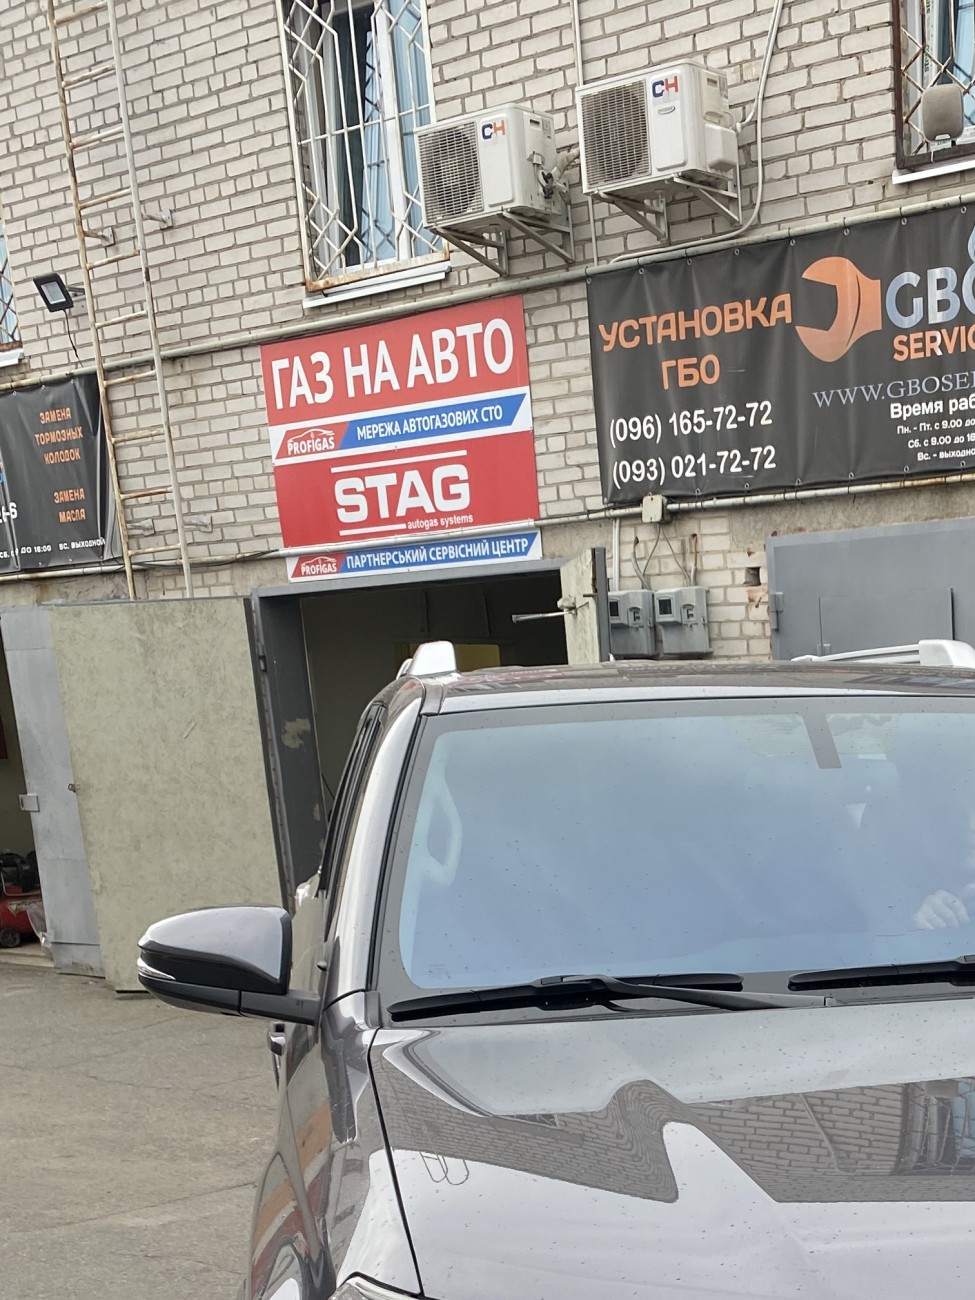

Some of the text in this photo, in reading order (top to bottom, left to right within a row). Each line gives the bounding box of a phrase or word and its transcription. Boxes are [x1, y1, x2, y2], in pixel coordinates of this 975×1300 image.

[652, 76, 678, 98] CH
[482, 120, 505, 140] CH
[599, 293, 793, 352] УСТАНОВКА
[271, 318, 514, 410] ГАЗ НА АВТО
[661, 354, 720, 390] ГБО
[39, 407, 71, 424] ЗАМЕНА
[890, 400, 943, 421] Время
[357, 405, 502, 441] МЕРЕЖА АВТОГАЗОВИХ СТО
[610, 400, 772, 448] (096) 165-72-72
[920, 422, 932, 431] Пт.
[942, 418, 962, 429] 9.00
[965, 418, 975, 427] до
[35, 427, 83, 446] ТОРМОЗНЫХ
[287, 436, 335, 455] PROFIGAS
[954, 435, 964, 444] до
[44, 448, 81, 465] КОЛОДОК
[917, 451, 931, 461] Вс.
[612, 445, 776, 490] (093) 021-72-72
[54, 488, 85, 504] ЗАМЕНА
[334, 464, 470, 523] STAG
[59, 508, 86, 523] МАСЛА
[407, 513, 473, 532] autogas systems
[346, 536, 529, 570] ПАРТНЕРСЬКИЙ СЕРВІСНИЙ ЦЕНТР
[301, 561, 337, 575] PROFIGAS
